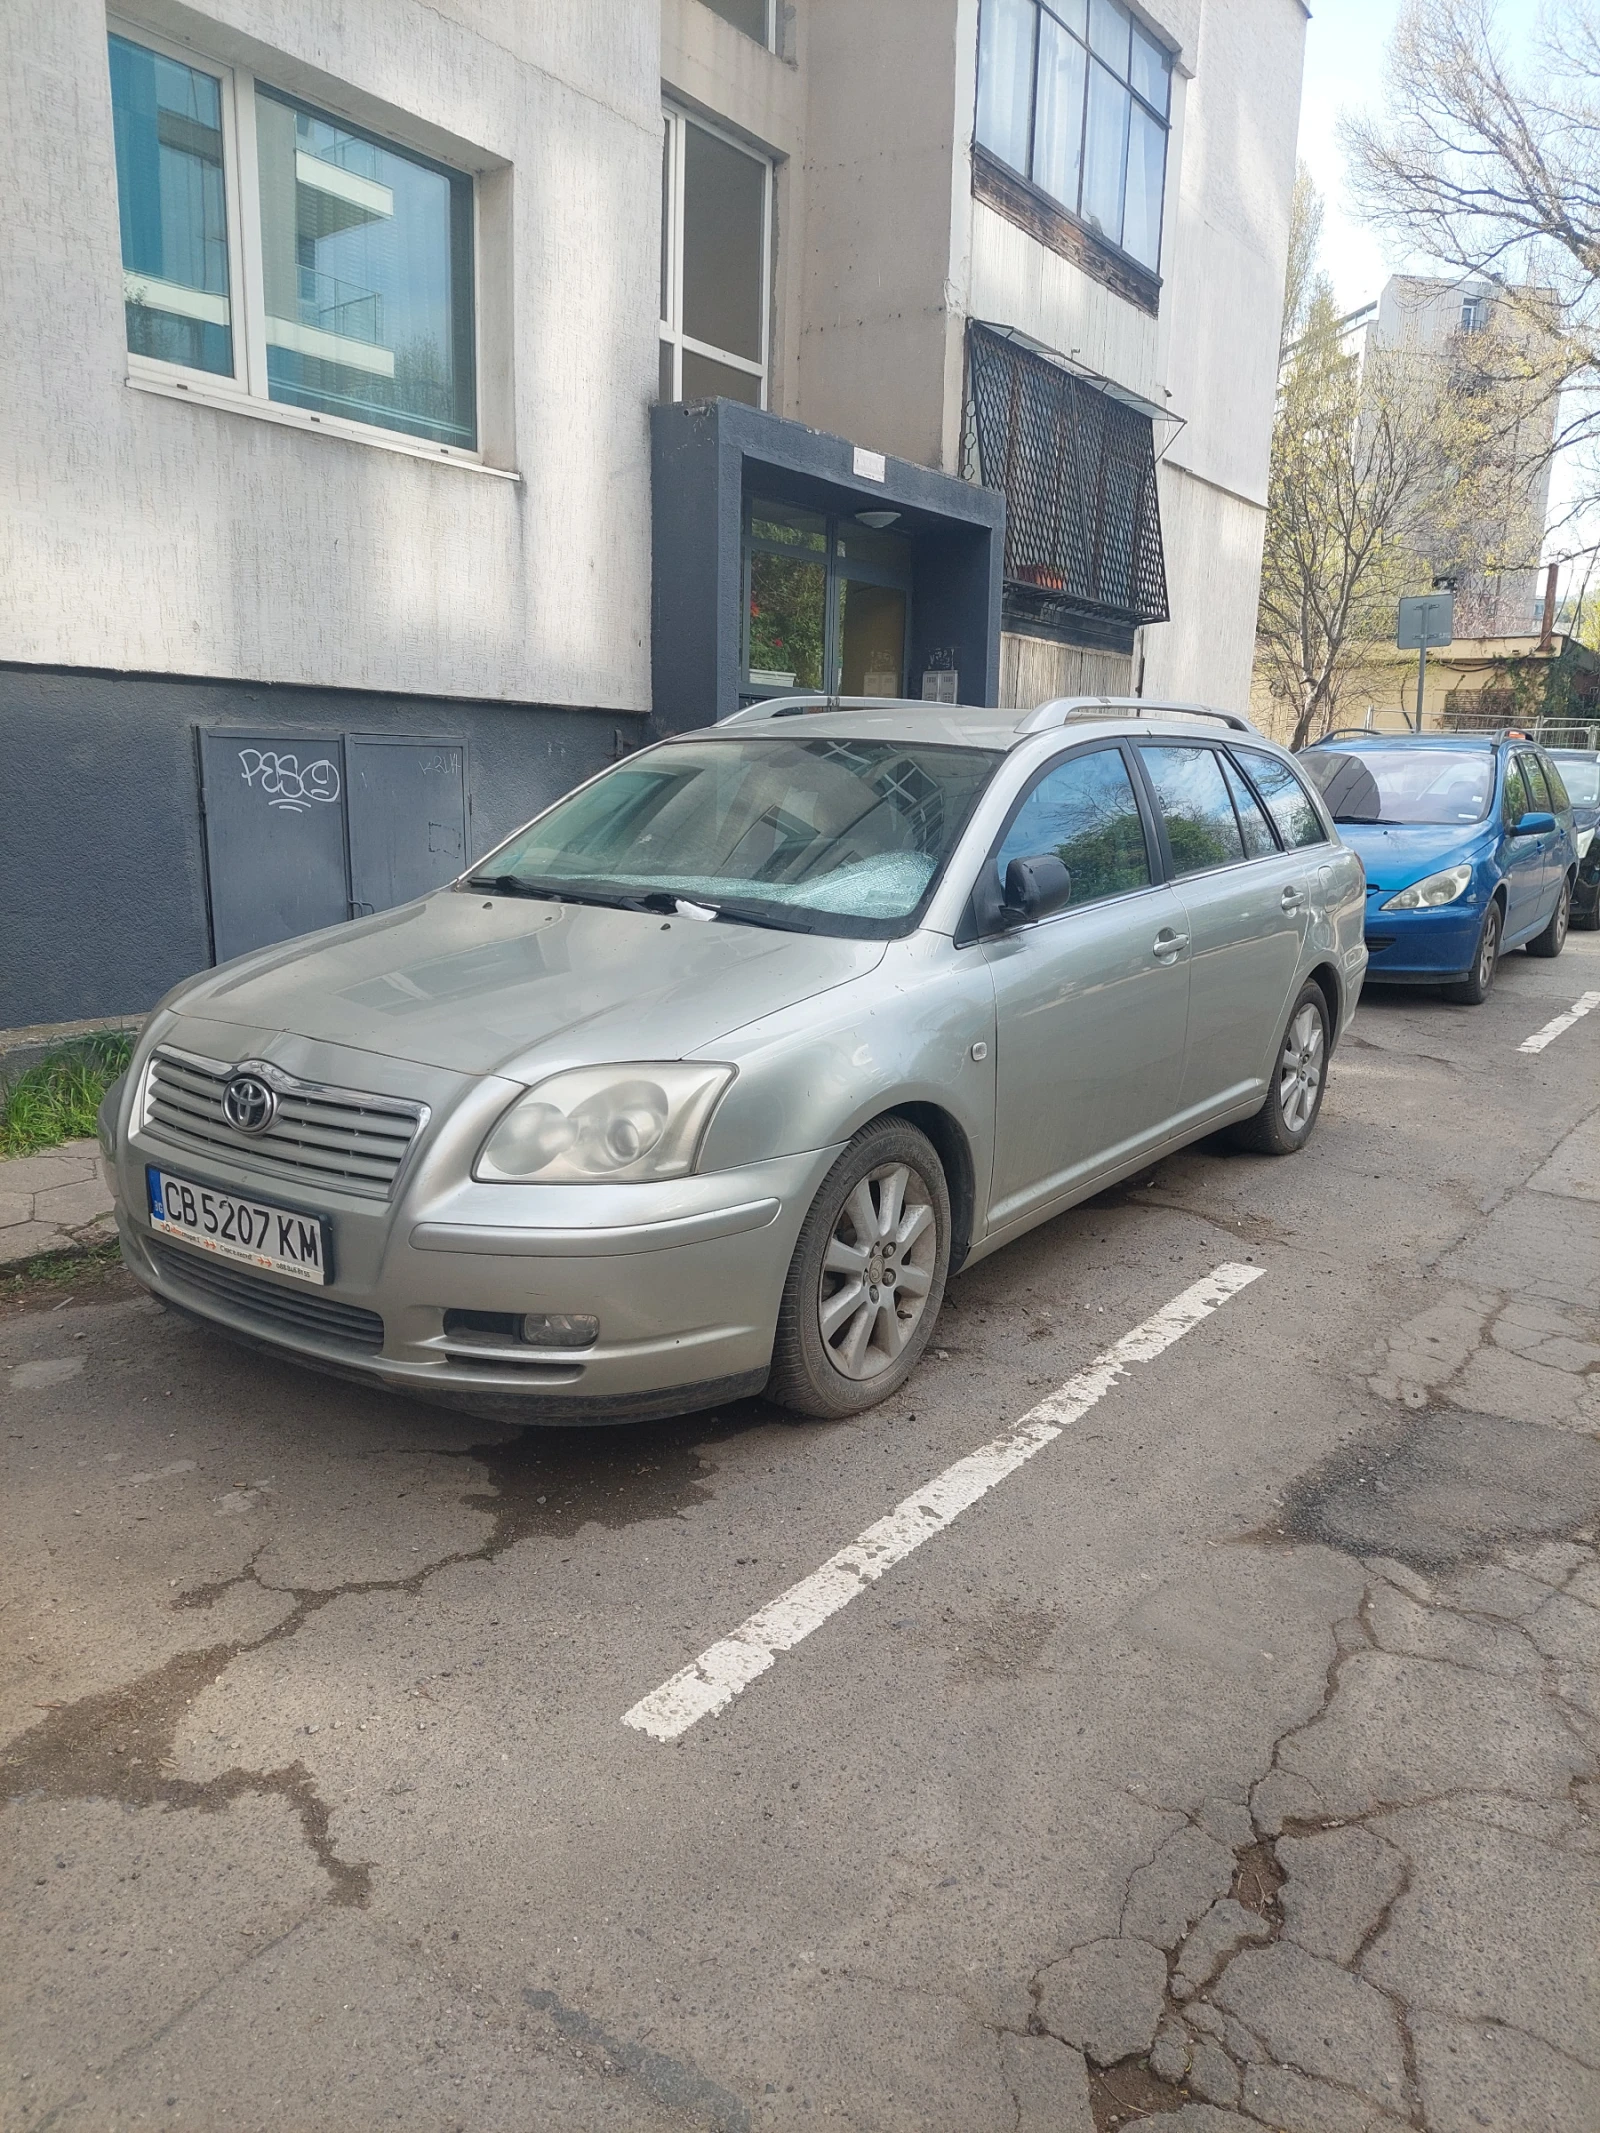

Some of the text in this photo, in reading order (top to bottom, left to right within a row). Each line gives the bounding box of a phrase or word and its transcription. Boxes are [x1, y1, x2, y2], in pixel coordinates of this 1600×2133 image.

[165, 1181, 319, 1267] CB 5207 KM
